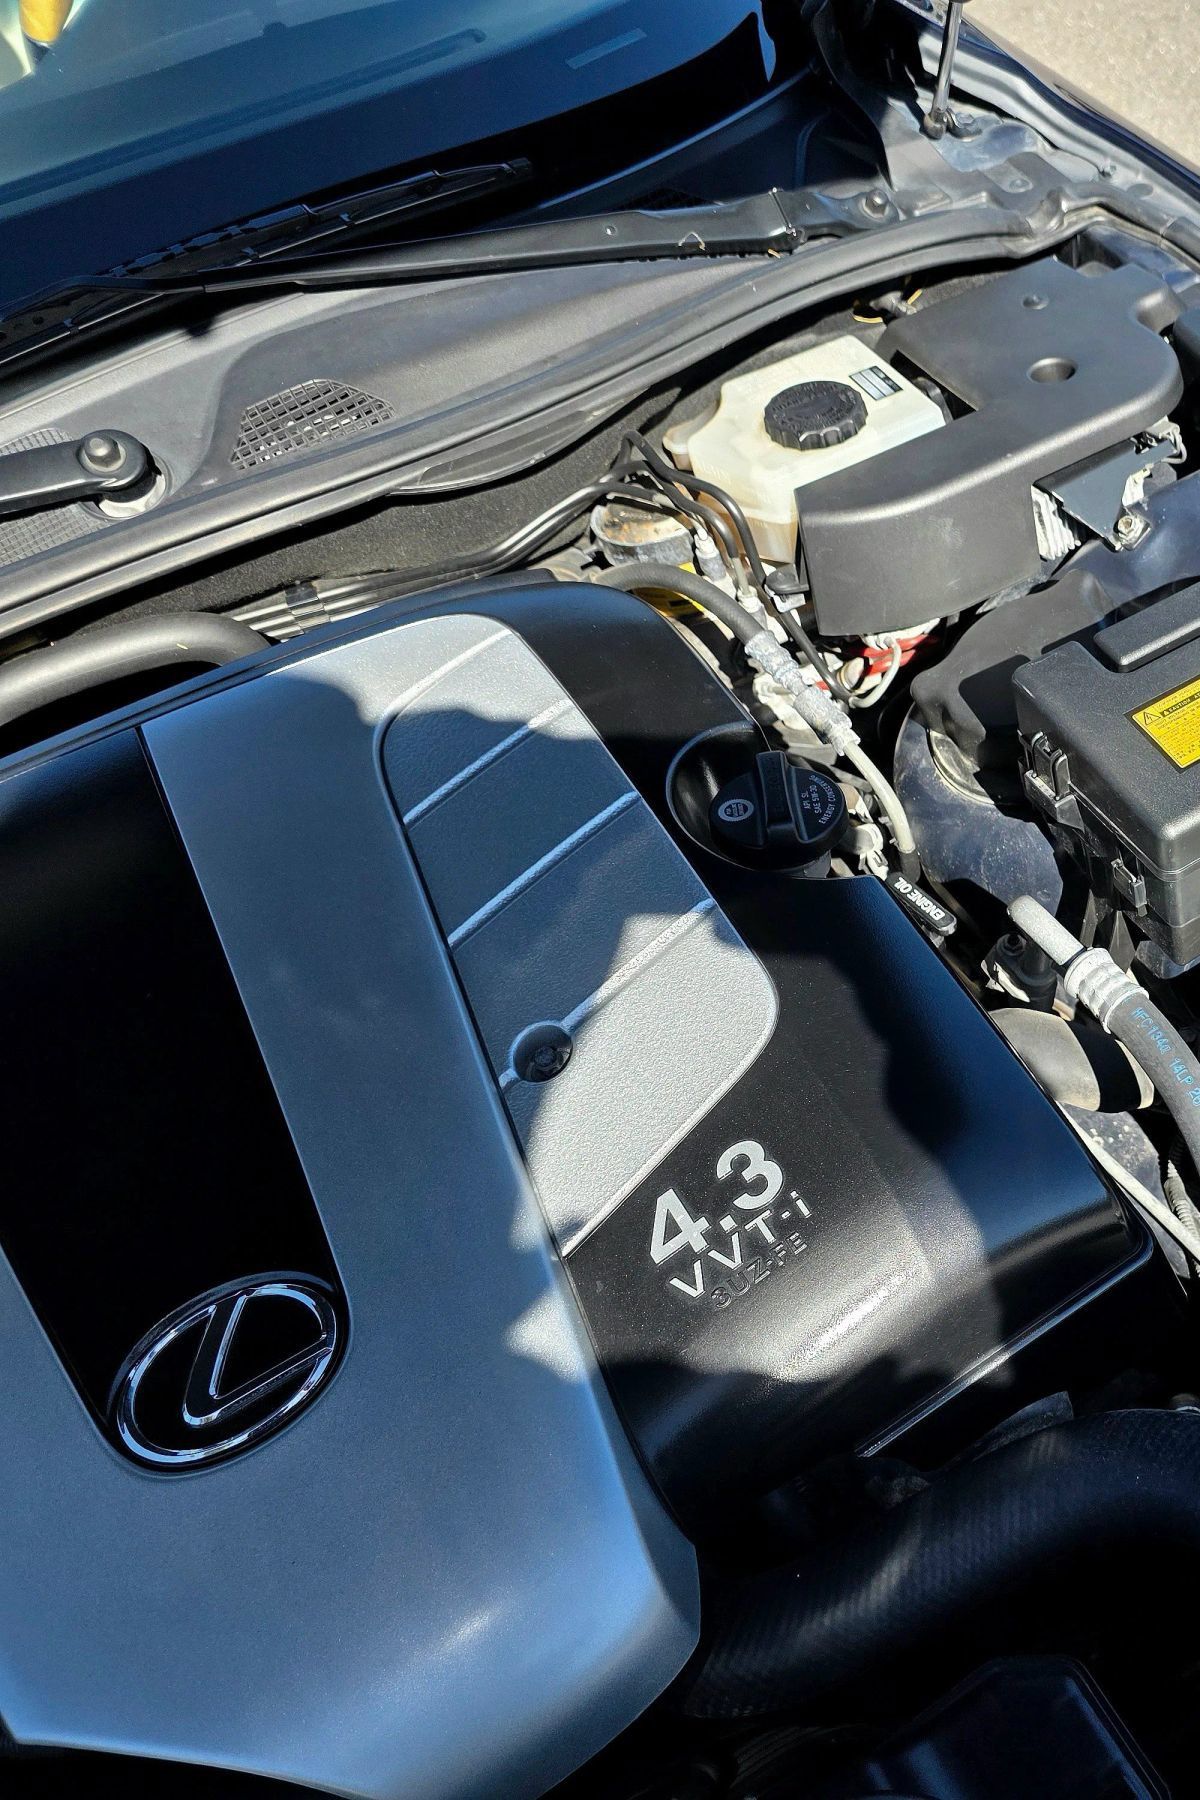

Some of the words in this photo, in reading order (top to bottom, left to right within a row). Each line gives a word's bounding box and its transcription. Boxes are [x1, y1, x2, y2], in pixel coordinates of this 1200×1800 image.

[1166, 697, 1191, 712] CAUTION
[809, 784, 818, 802] 5W-30
[814, 801, 822, 814] SAE
[818, 803, 836, 824] ENERGY
[892, 876, 914, 894] OIL
[909, 888, 945, 920] ENGINE
[648, 1140, 785, 1265] 4.3
[669, 1190, 812, 1300] VVT-i
[709, 1224, 809, 1310] 3UZ-FE
